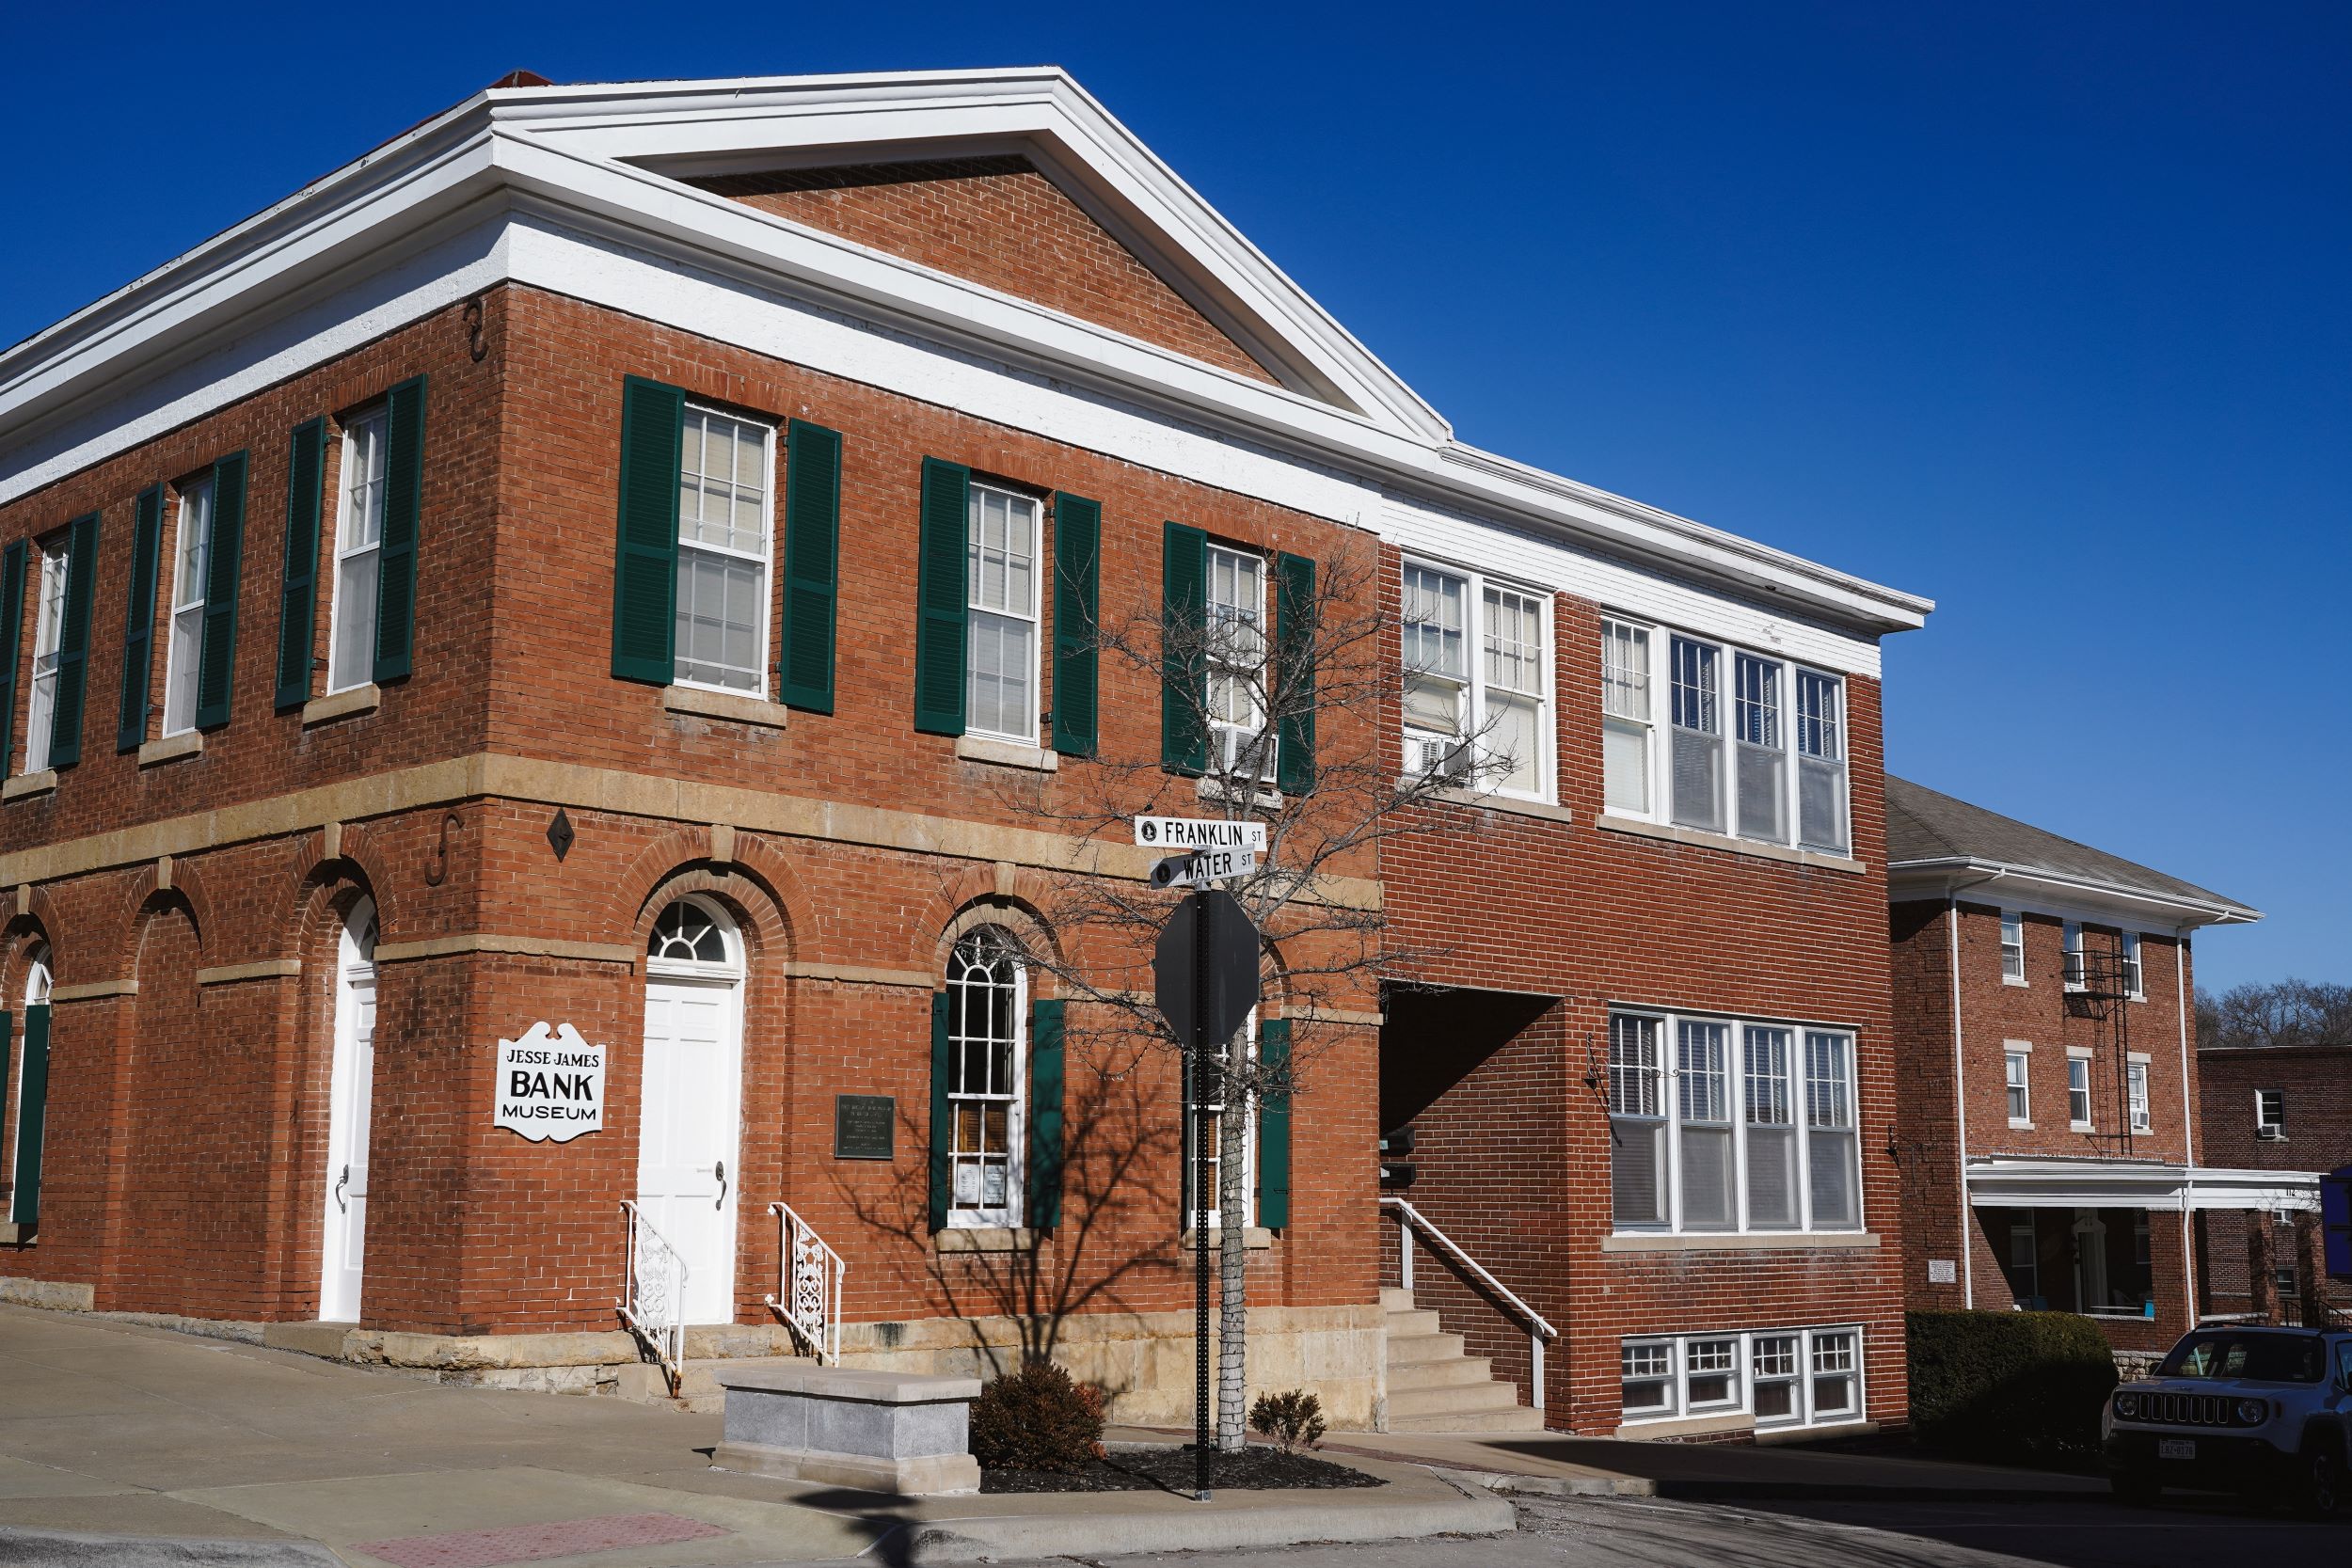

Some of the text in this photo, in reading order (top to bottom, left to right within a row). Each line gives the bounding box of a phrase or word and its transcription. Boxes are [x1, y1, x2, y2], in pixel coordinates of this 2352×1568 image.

[1165, 821, 1262, 846] FRANKLIN ST
[1183, 852, 1251, 880] WATER ST
[506, 1049, 599, 1068] JESSE JAMES
[510, 1069, 594, 1101] BANK
[502, 1103, 596, 1120] MUSEUM
